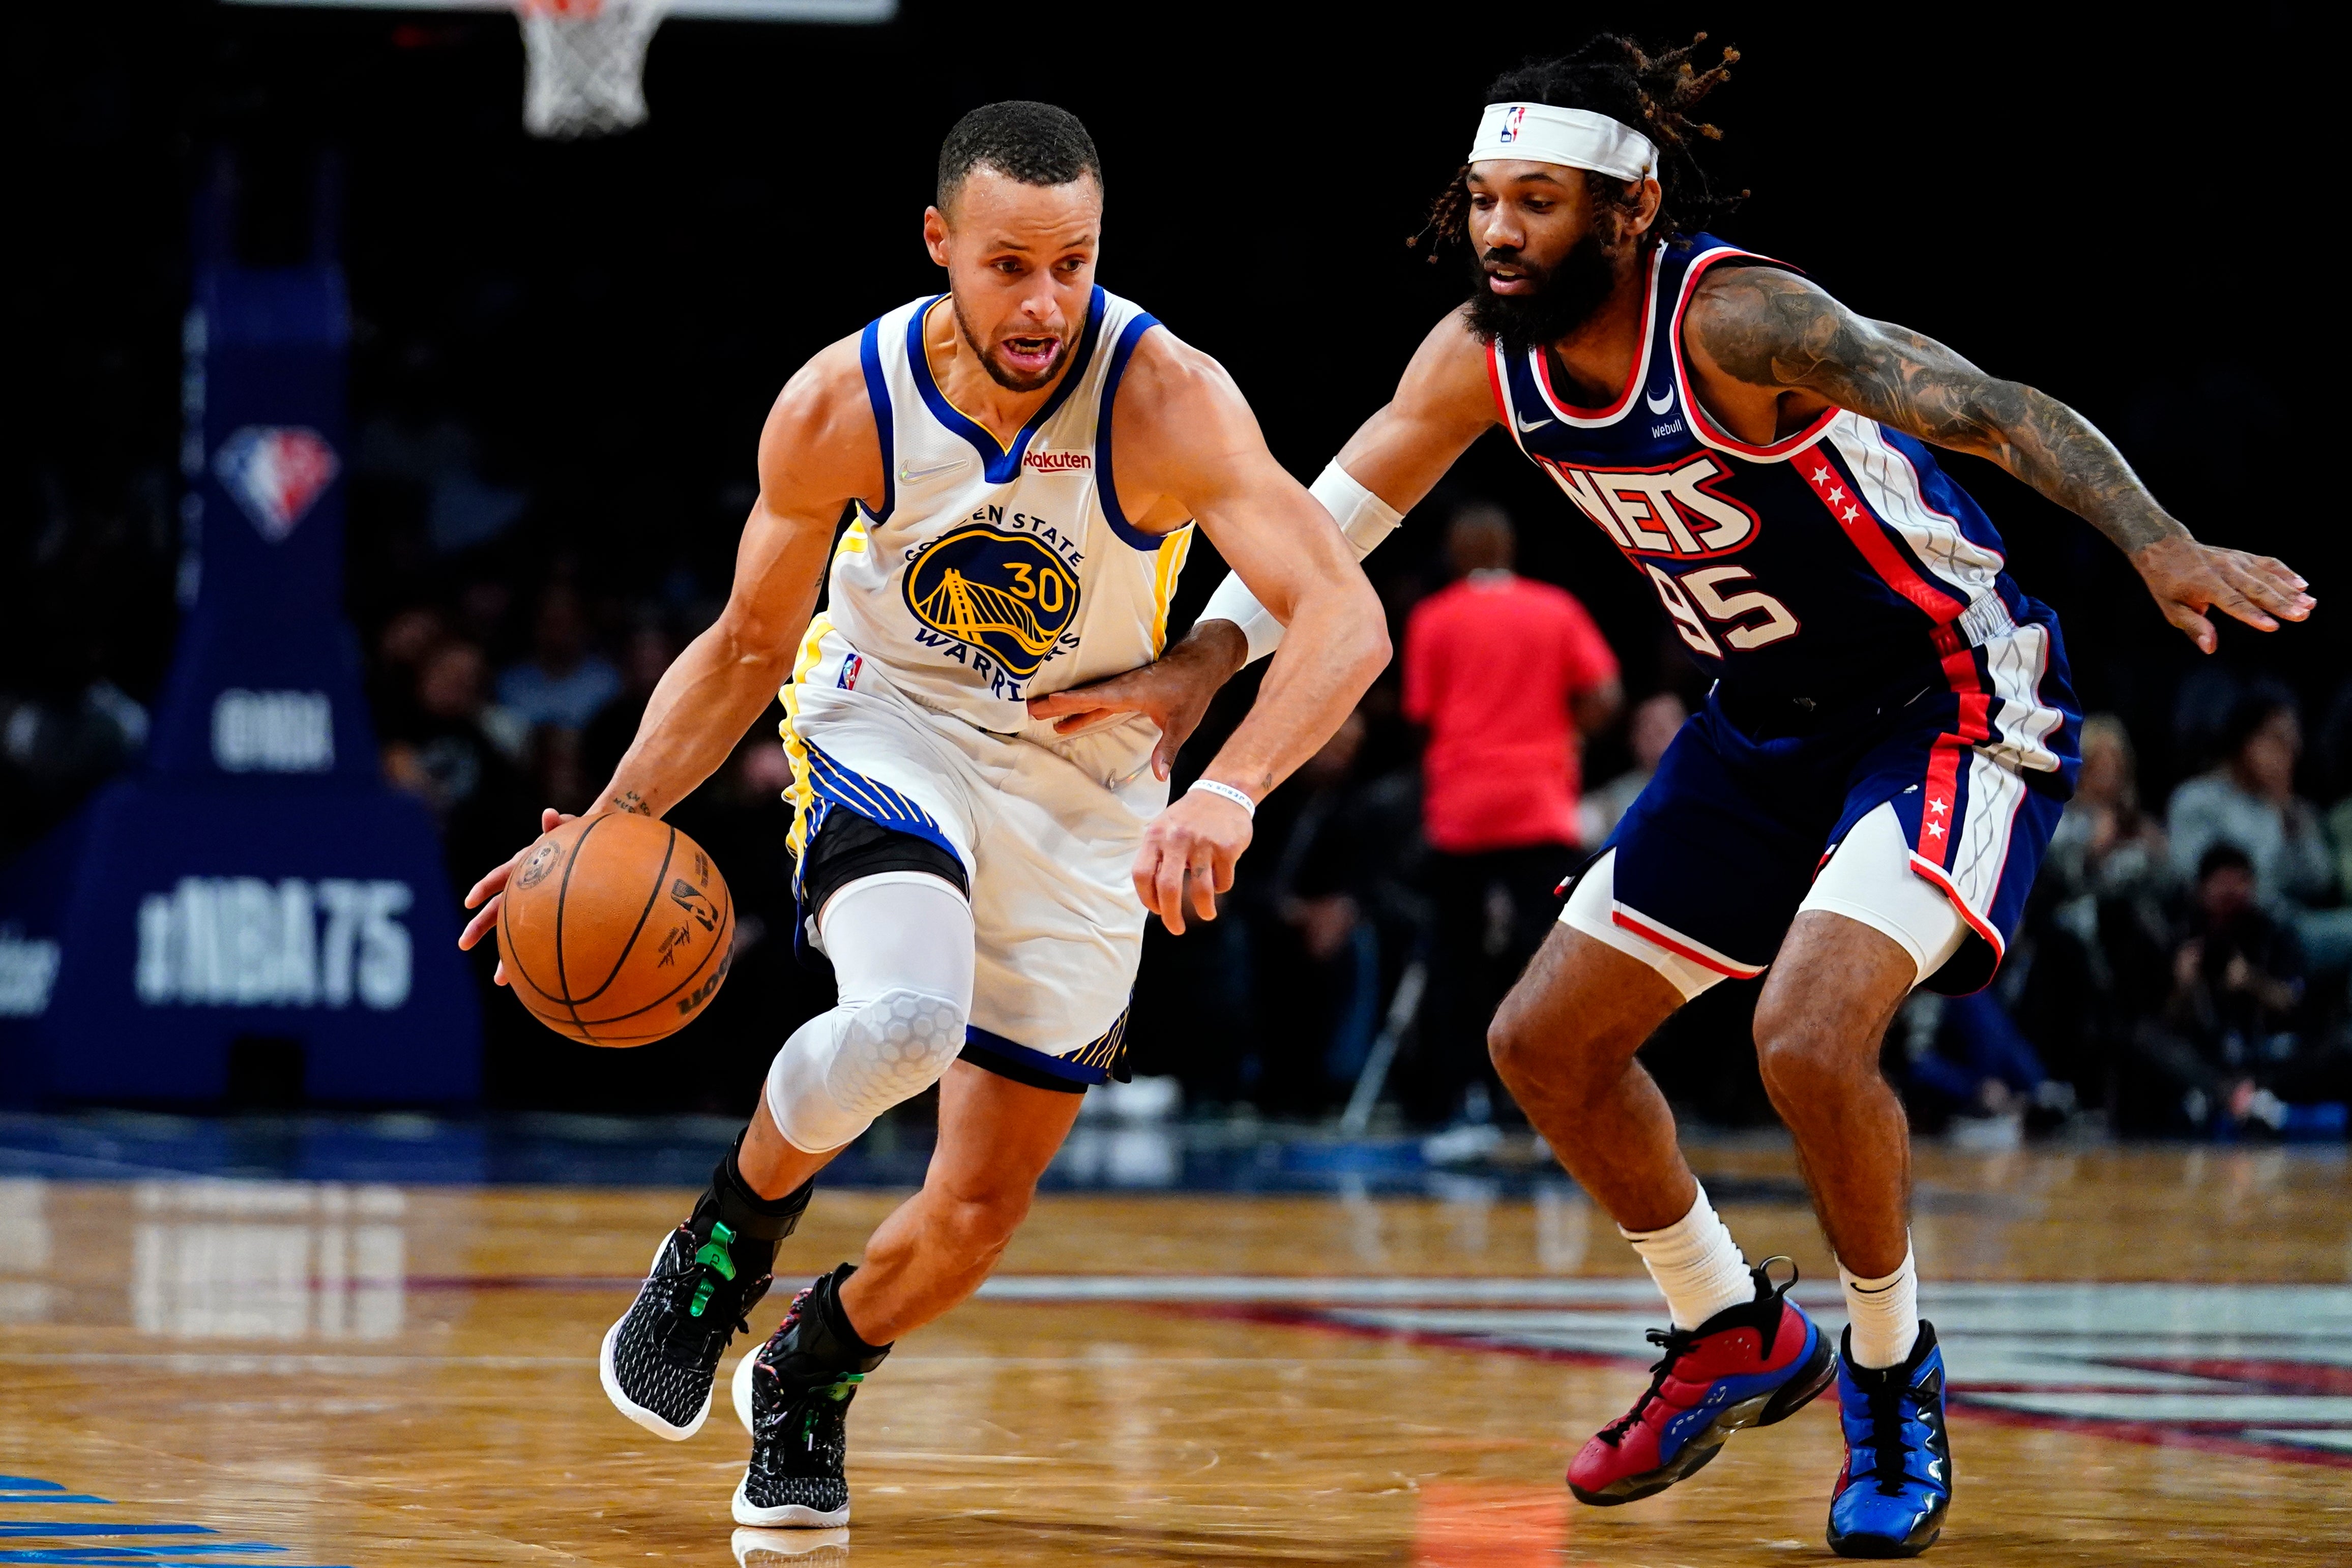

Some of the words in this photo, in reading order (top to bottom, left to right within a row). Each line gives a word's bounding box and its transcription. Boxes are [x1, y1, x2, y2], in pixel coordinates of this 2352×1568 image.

[1651, 419, 1683, 438] Webull
[1023, 450, 1092, 469] Rakuten
[1536, 450, 1759, 560] NETS
[1012, 513, 1085, 567] STATE
[1002, 562, 1064, 612] 30
[1644, 563, 1801, 661] 95
[915, 627, 1080, 702] WARRIRS
